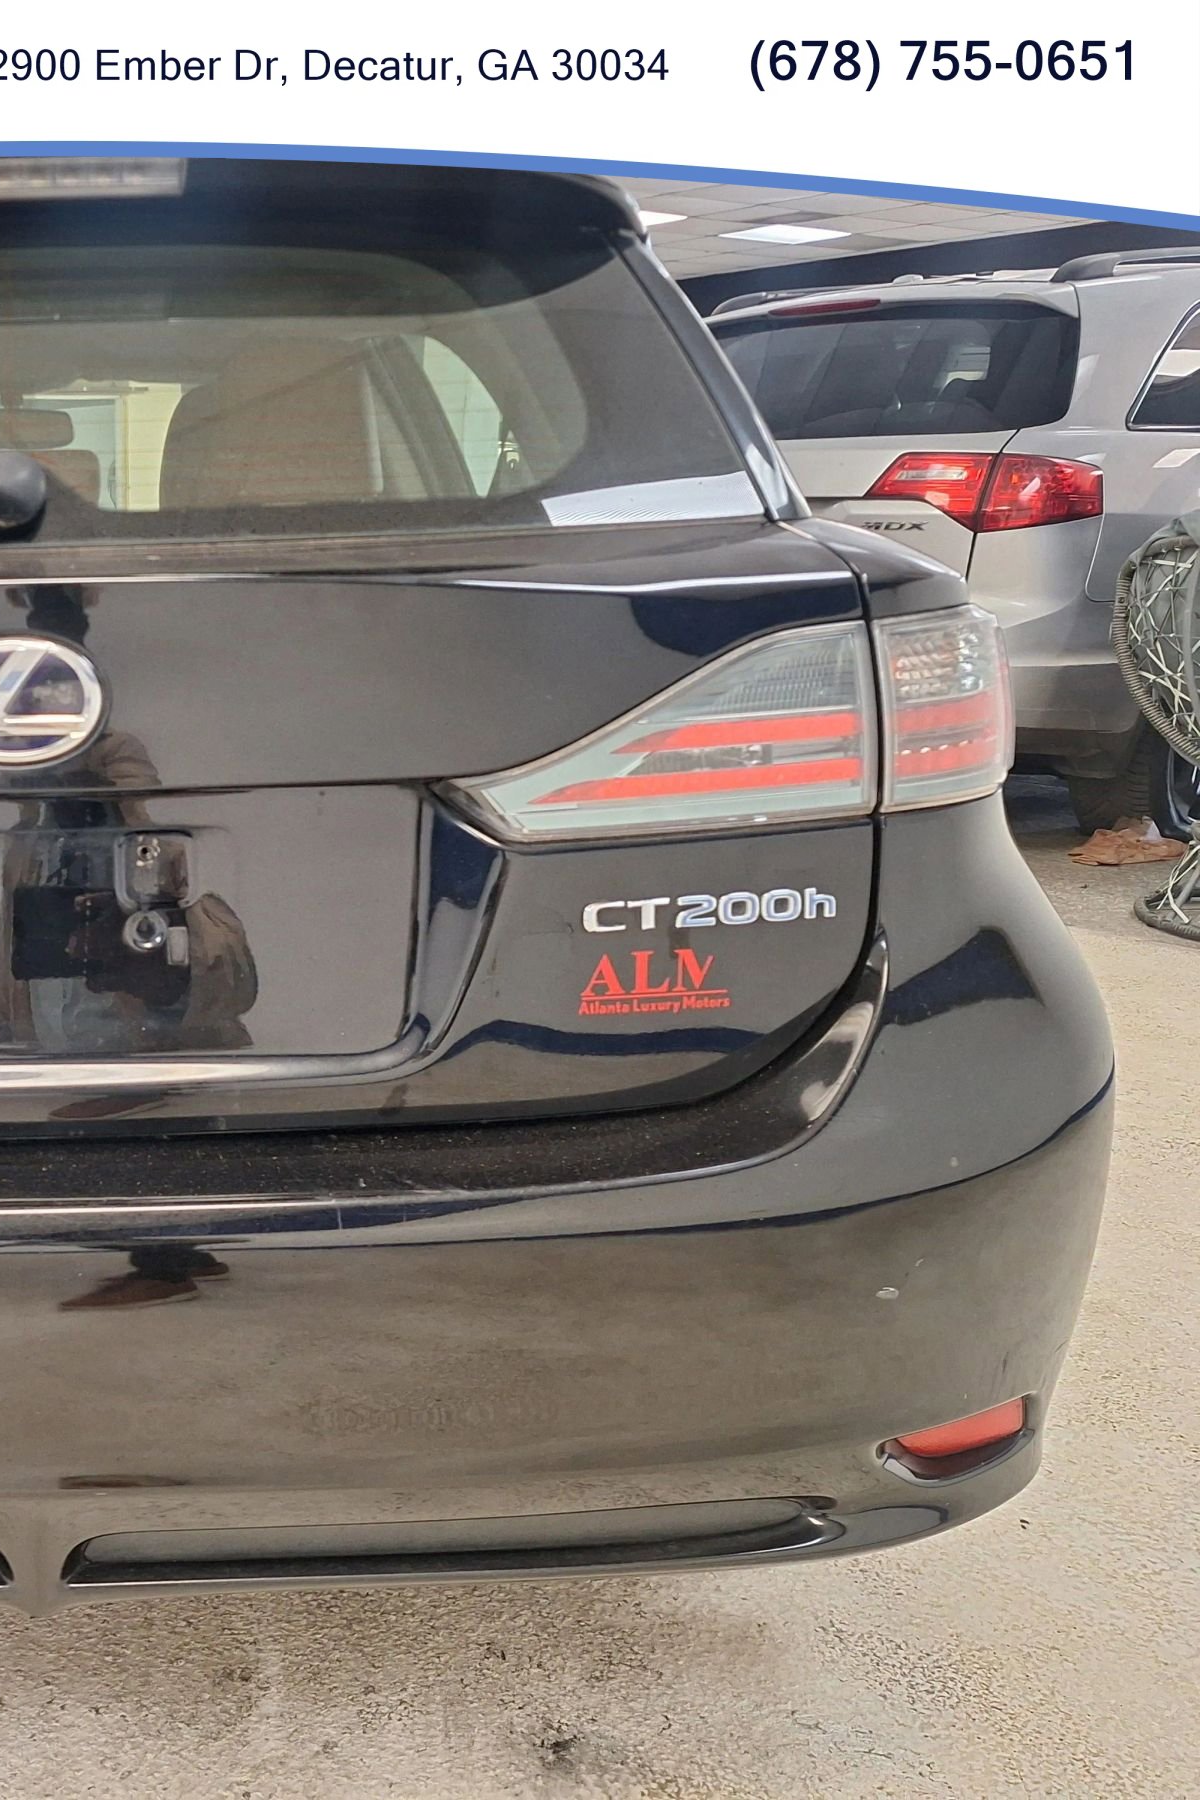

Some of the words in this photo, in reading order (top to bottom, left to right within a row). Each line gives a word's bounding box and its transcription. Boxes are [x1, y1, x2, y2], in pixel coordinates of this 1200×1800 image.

[578, 1001, 630, 1016] Atlanta
[632, 999, 681, 1014] Luxury
[682, 995, 731, 1010] Motors
